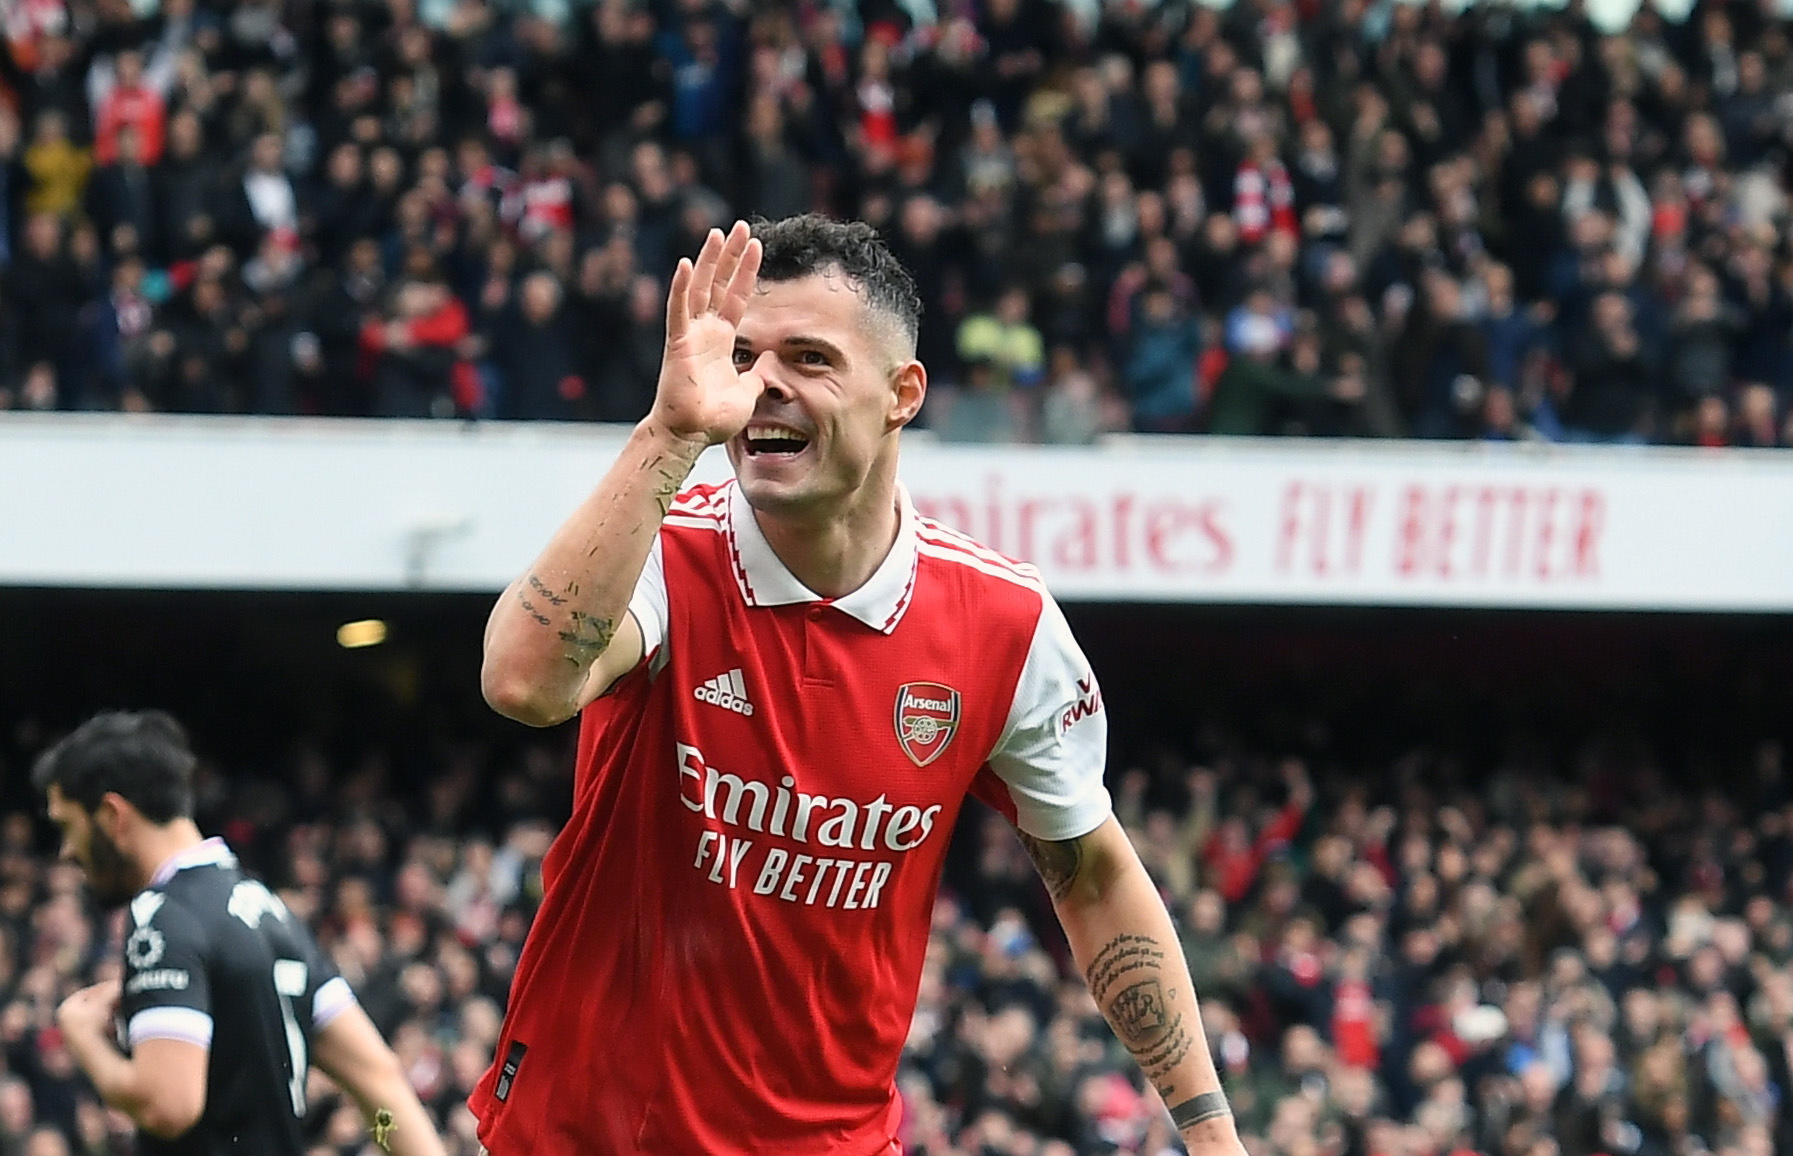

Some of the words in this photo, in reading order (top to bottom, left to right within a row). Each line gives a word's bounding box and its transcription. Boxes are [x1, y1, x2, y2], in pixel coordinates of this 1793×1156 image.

[914, 474, 1235, 574] irates
[1275, 479, 1381, 575] FLY
[1394, 482, 1607, 582] BETTER
[694, 683, 755, 717] adidas
[904, 694, 951, 713] Arsenal
[676, 740, 942, 852] Emirates
[693, 830, 751, 890] FLY
[753, 847, 893, 910] BETTER
